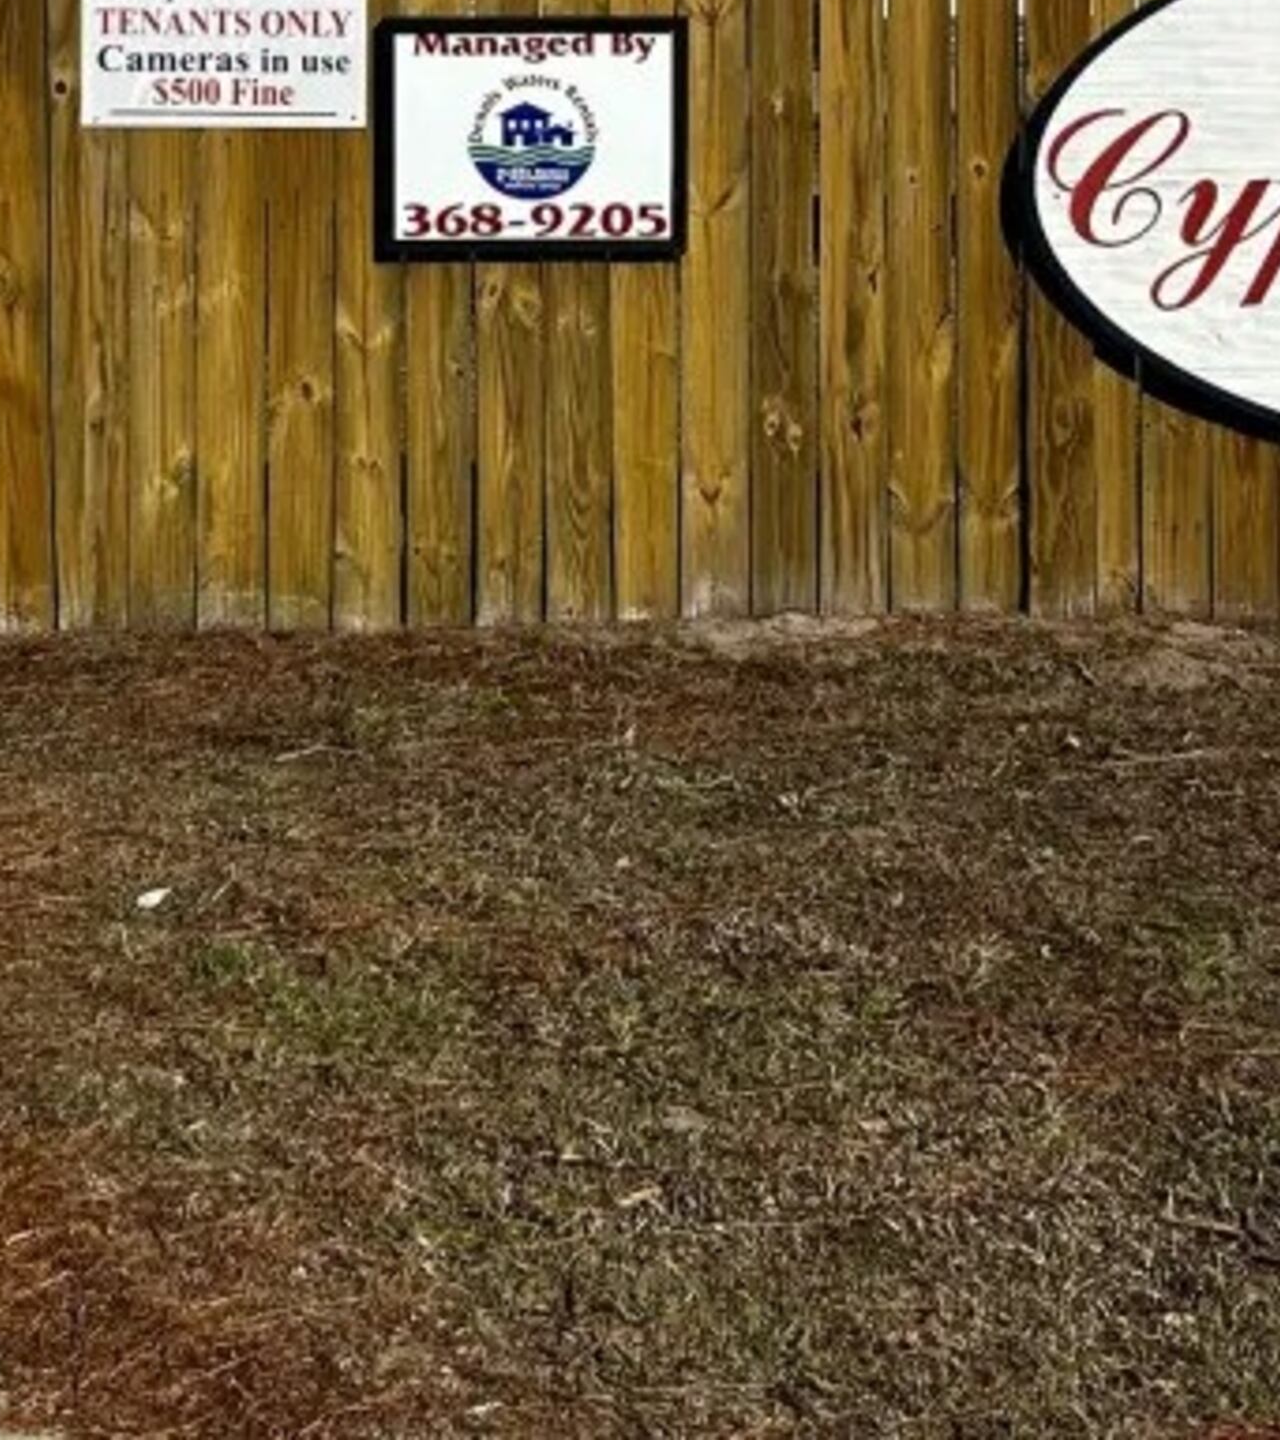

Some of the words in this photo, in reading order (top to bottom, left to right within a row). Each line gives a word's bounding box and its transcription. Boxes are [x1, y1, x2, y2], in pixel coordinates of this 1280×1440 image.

[97, 8, 251, 36] TENANTS
[260, 10, 350, 37] ONLY
[98, 45, 250, 72] Cameras
[261, 48, 289, 73] in
[301, 55, 351, 74] use
[414, 33, 594, 63] Managed
[611, 33, 655, 63] By
[152, 78, 220, 106] $500
[230, 78, 294, 106] Fine
[403, 202, 667, 237] 368-9205
